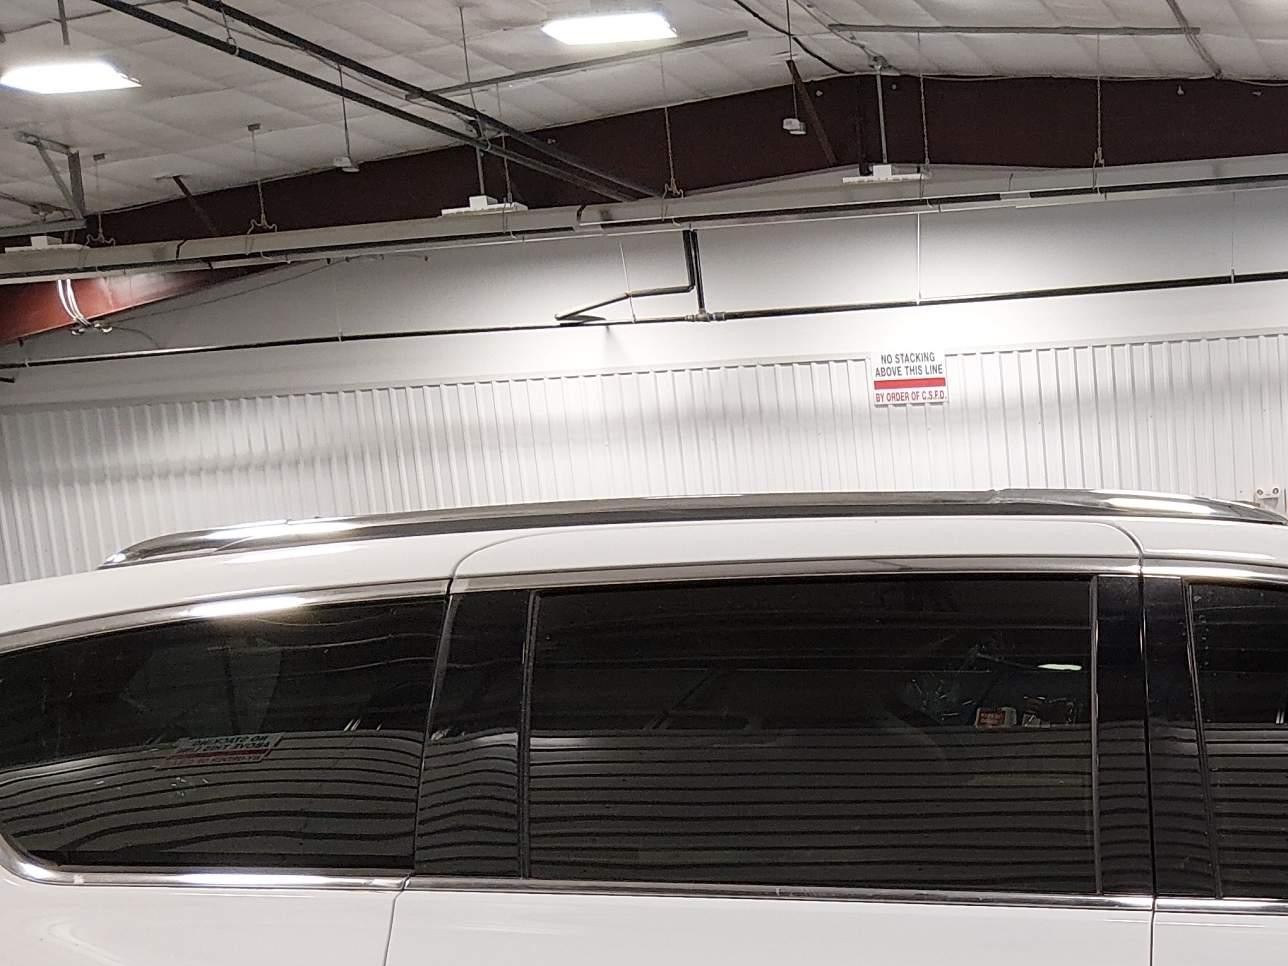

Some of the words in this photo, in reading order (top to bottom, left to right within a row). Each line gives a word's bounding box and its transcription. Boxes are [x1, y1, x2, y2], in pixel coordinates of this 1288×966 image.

[881, 354, 893, 365] NO
[895, 352, 935, 364] STACKING
[875, 366, 903, 377] ABOVE
[904, 365, 923, 376] THIS
[925, 364, 944, 375] LINE
[875, 392, 885, 402] BY
[886, 391, 910, 402] ORDER
[911, 391, 920, 401] OF
